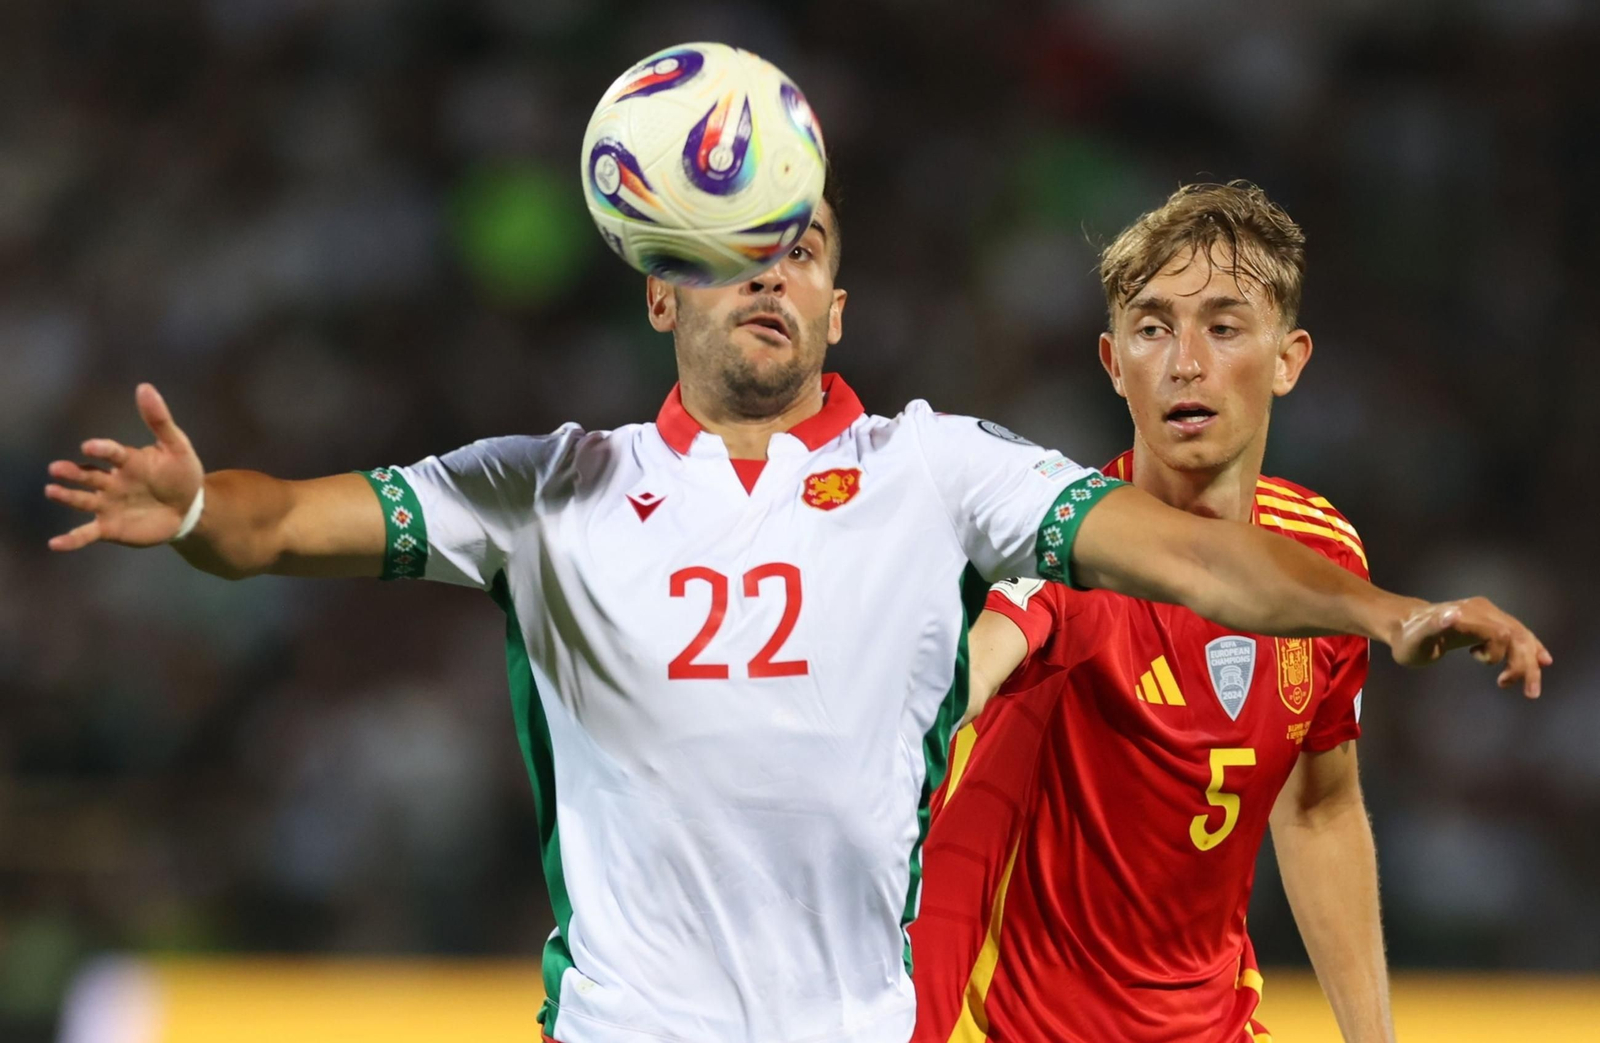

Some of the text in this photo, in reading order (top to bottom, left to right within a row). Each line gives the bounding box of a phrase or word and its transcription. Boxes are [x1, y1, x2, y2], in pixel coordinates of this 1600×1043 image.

[668, 562, 808, 680] 22
[1210, 647, 1250, 659] EUROPEAN
[1211, 655, 1251, 667] CHAMPIONS
[1222, 690, 1243, 700] 2024
[1189, 748, 1256, 851] 5
